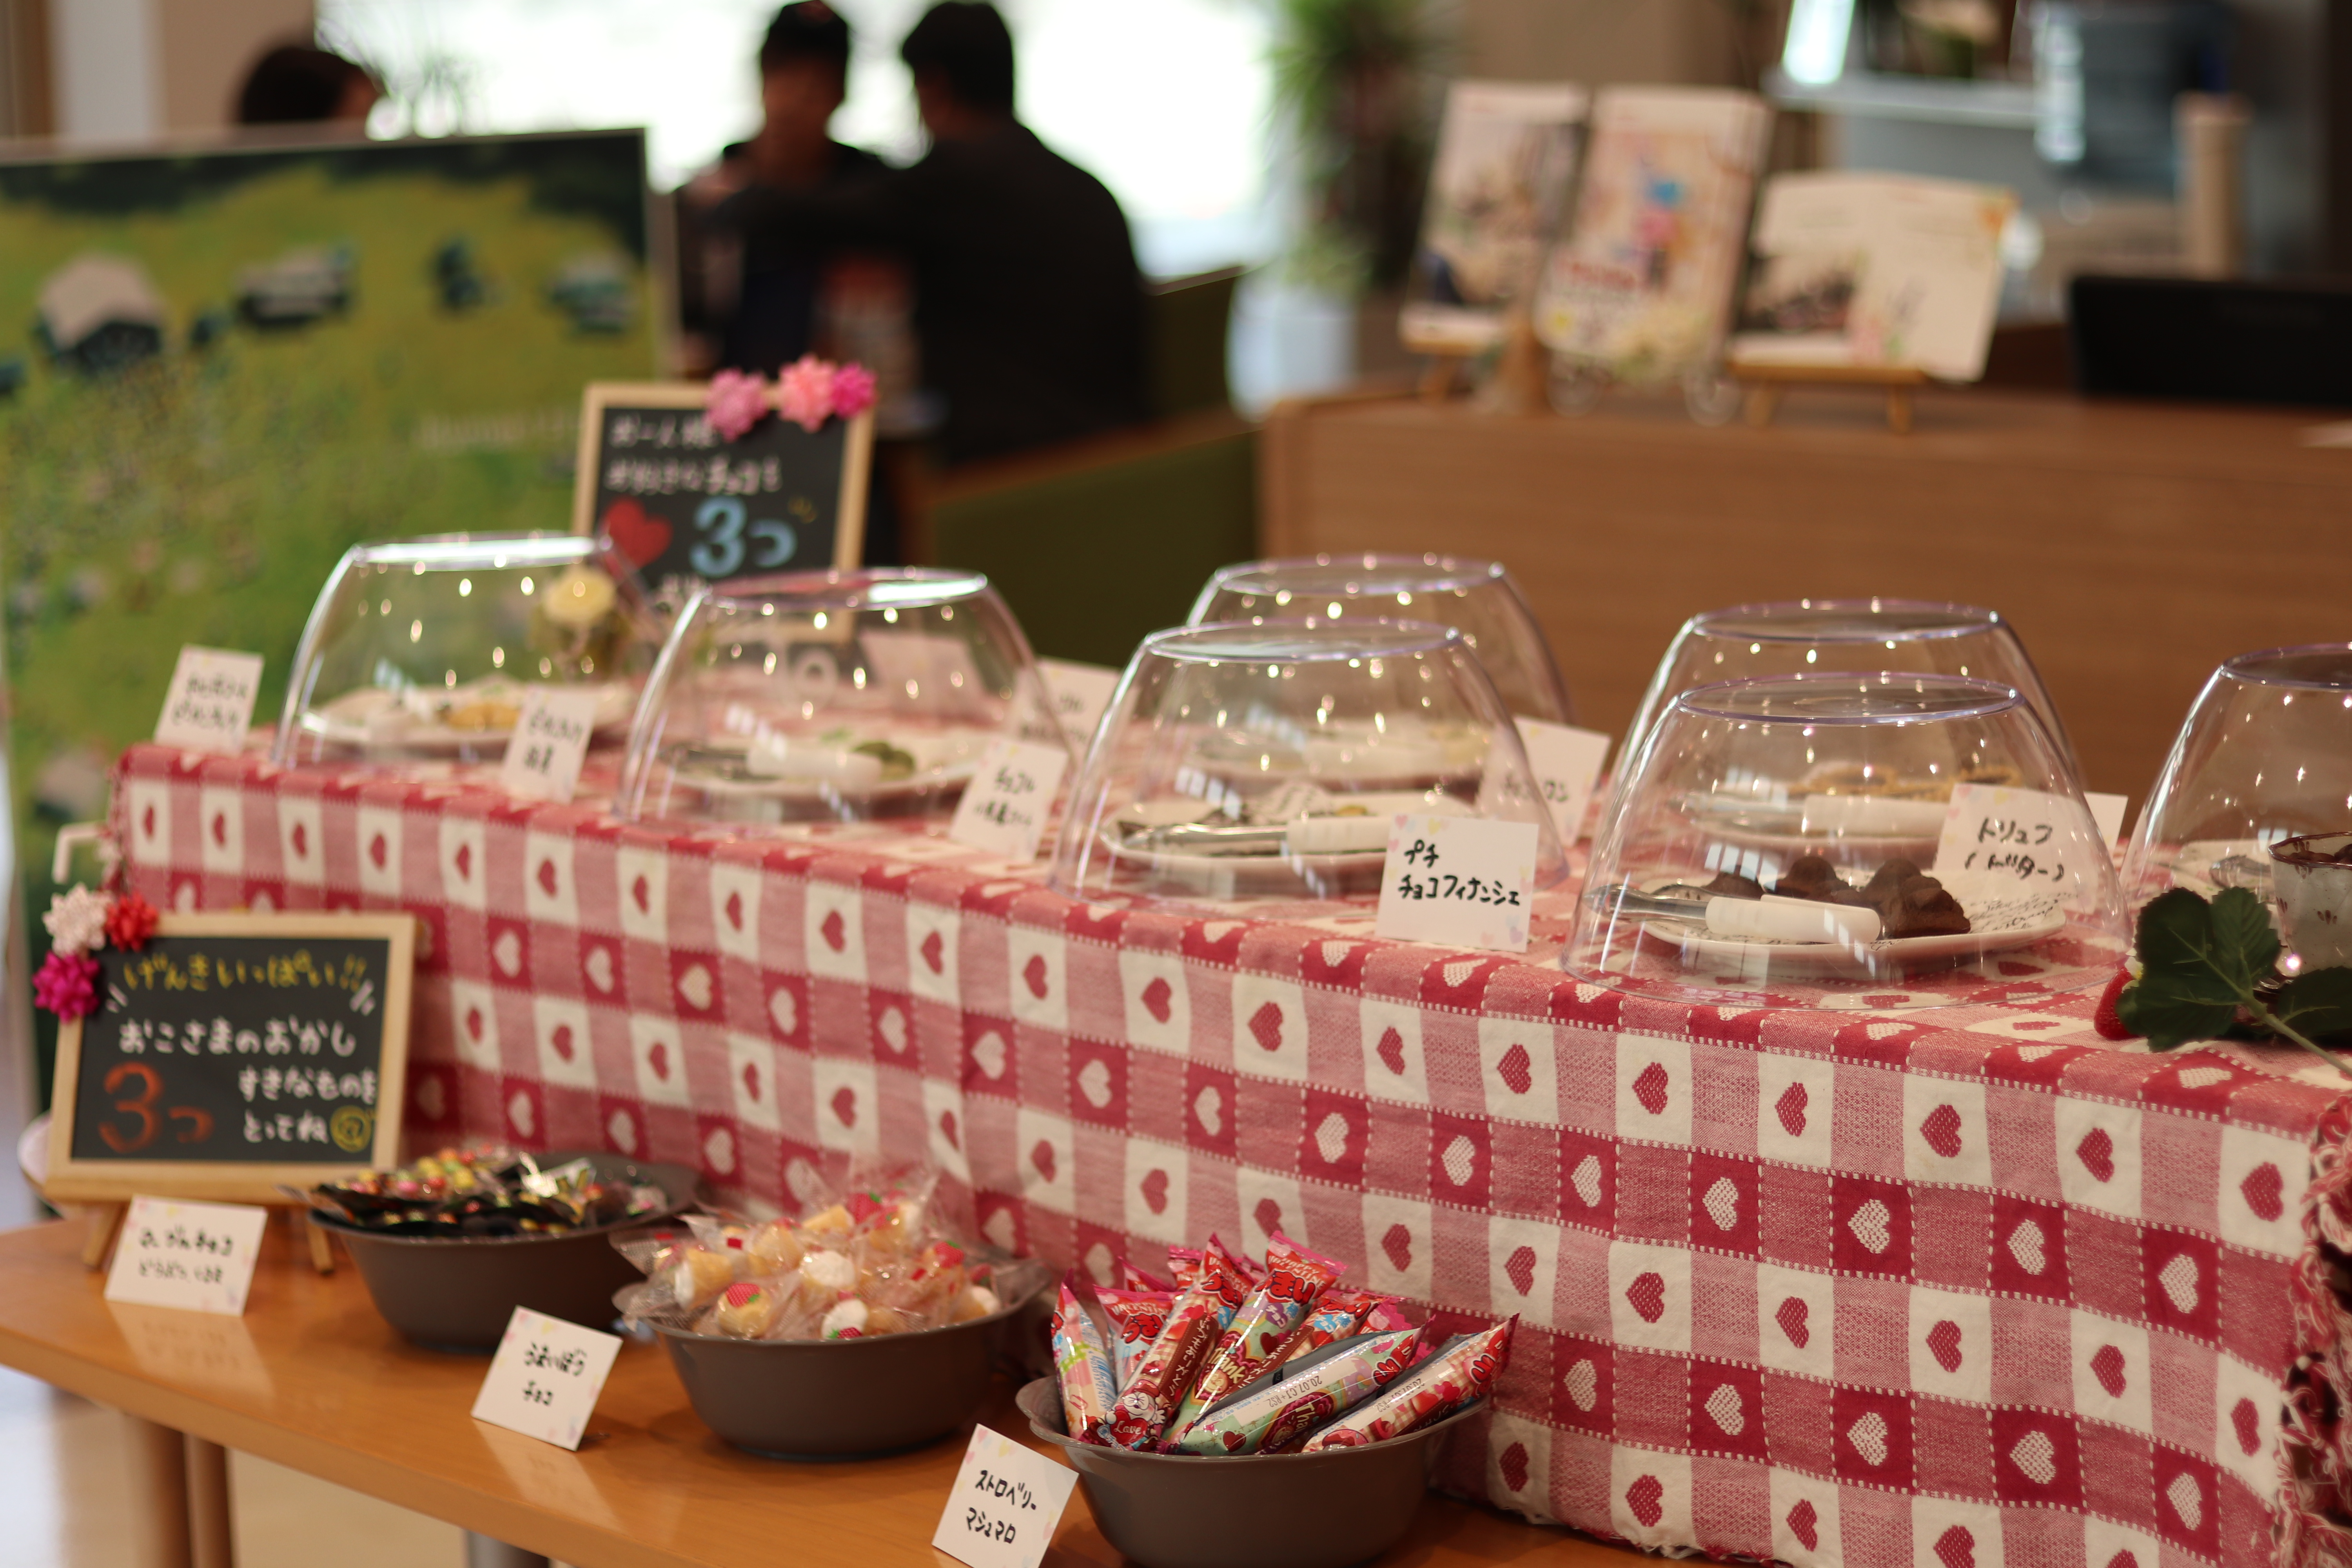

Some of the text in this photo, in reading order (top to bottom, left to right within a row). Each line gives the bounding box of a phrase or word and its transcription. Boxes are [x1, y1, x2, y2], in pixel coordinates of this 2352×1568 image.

[1977, 817, 2053, 845] トリュフ
[1404, 839, 1439, 868] プチ
[1397, 874, 1520, 906] チョコフィナンシェ
[119, 1014, 356, 1057] おこさまのおかし
[238, 1064, 377, 1105] すきなものを
[98, 1062, 214, 1153] 3つ
[243, 1110, 330, 1144] とってね
[1281, 1258, 1319, 1275] HAPPY
[1168, 1318, 1211, 1397] いつもありがとう
[522, 1379, 554, 1406] チョコ
[1113, 1419, 1142, 1436] Love
[975, 1470, 1037, 1510] ストロベリー
[966, 1507, 1016, 1544] マシュマロ
